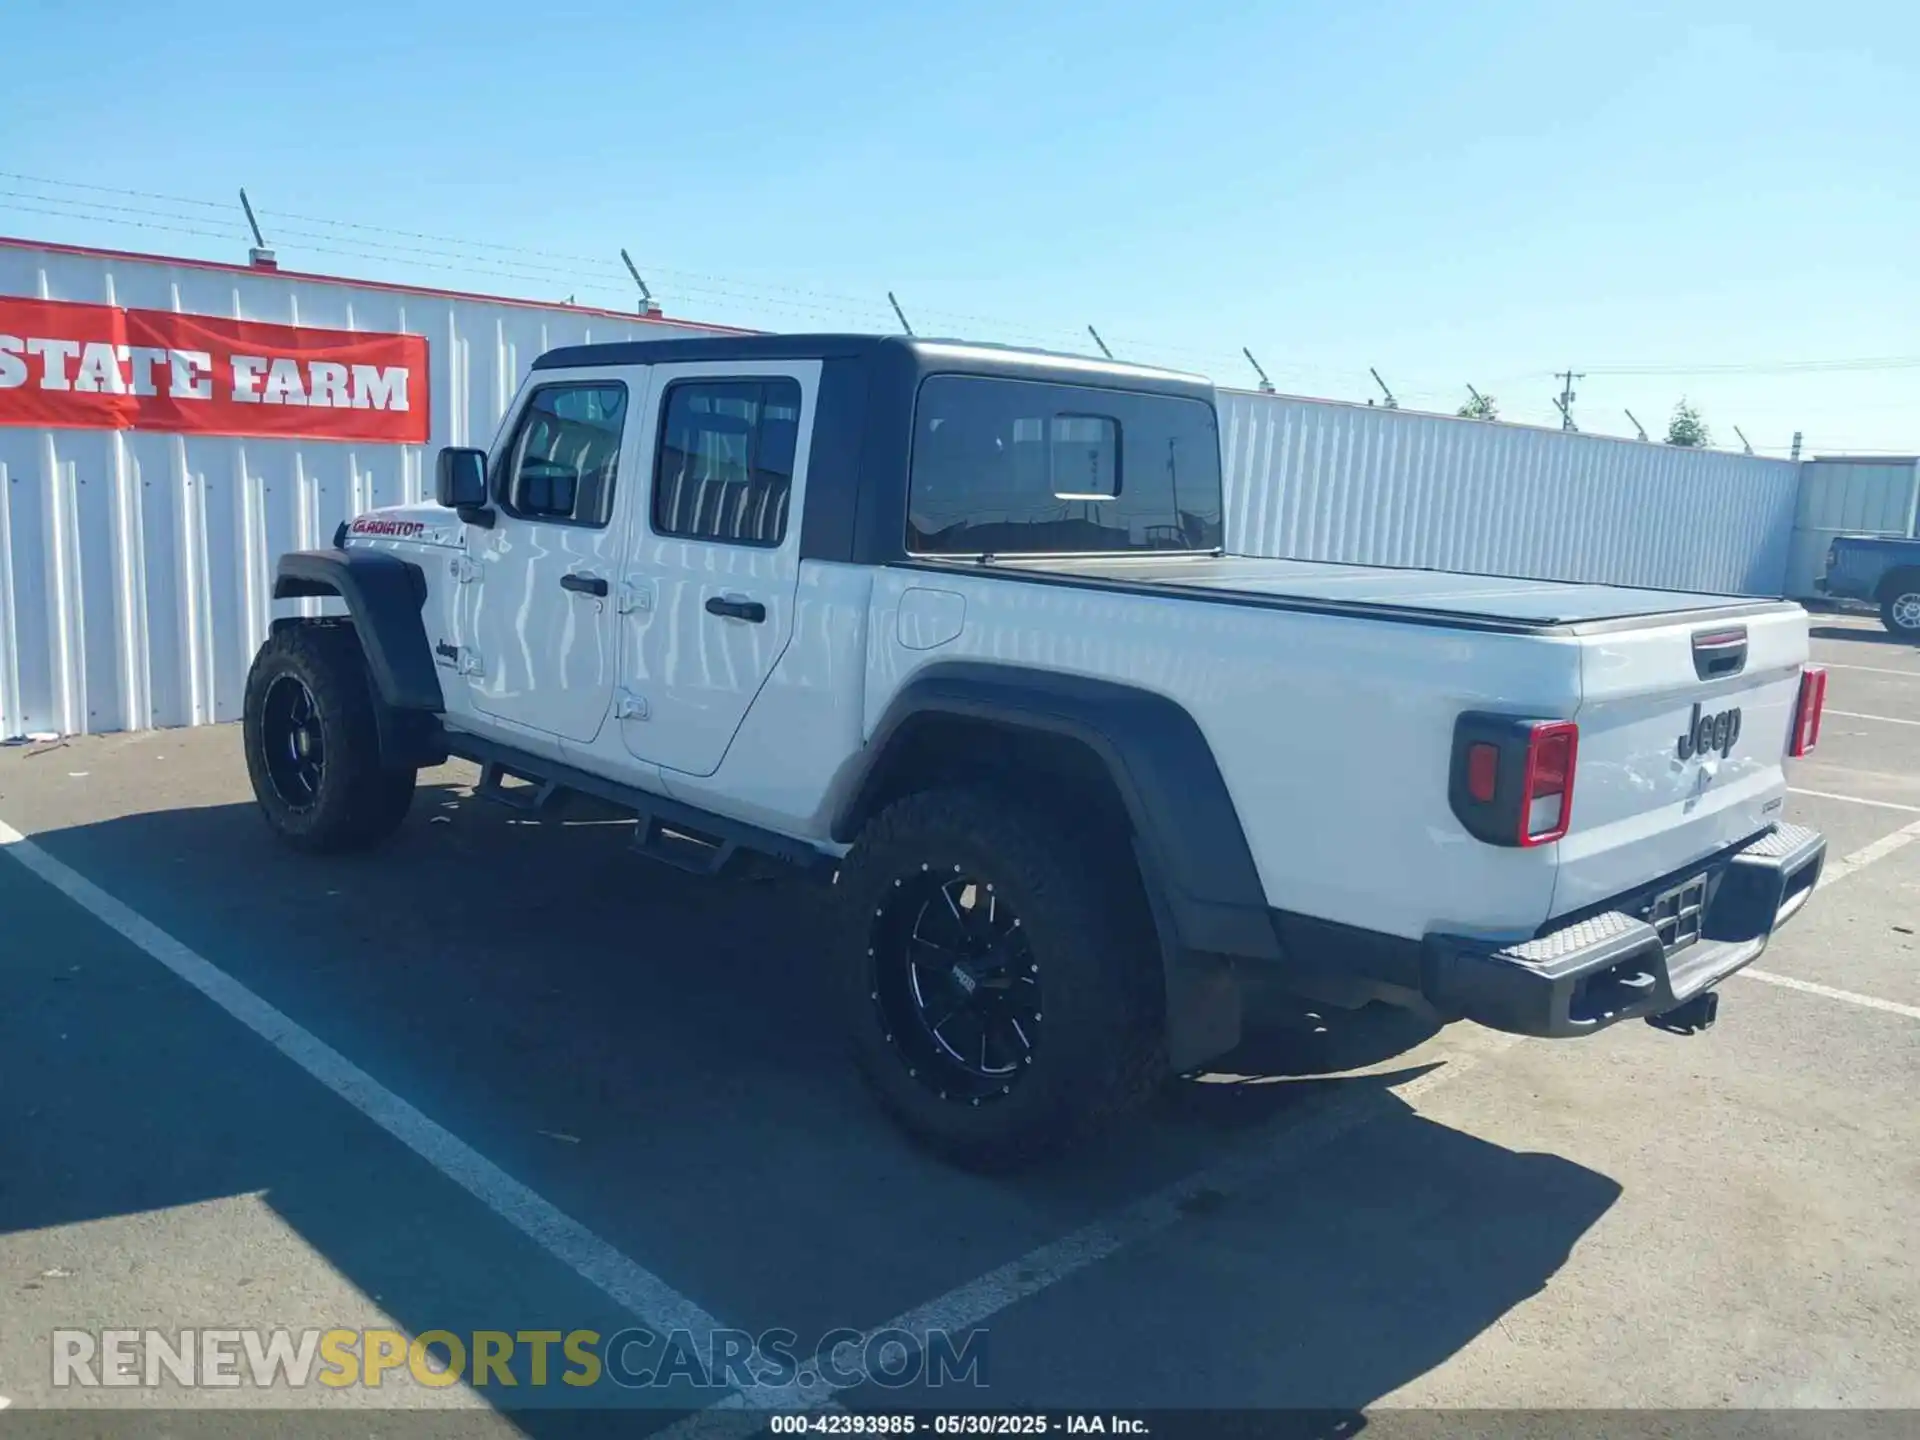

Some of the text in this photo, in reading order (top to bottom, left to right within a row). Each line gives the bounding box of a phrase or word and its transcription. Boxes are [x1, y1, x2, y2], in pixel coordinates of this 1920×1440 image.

[0, 334, 409, 412] STATE FARM
[353, 520, 425, 538] GLADIATOR
[1678, 702, 1742, 760] Jeep
